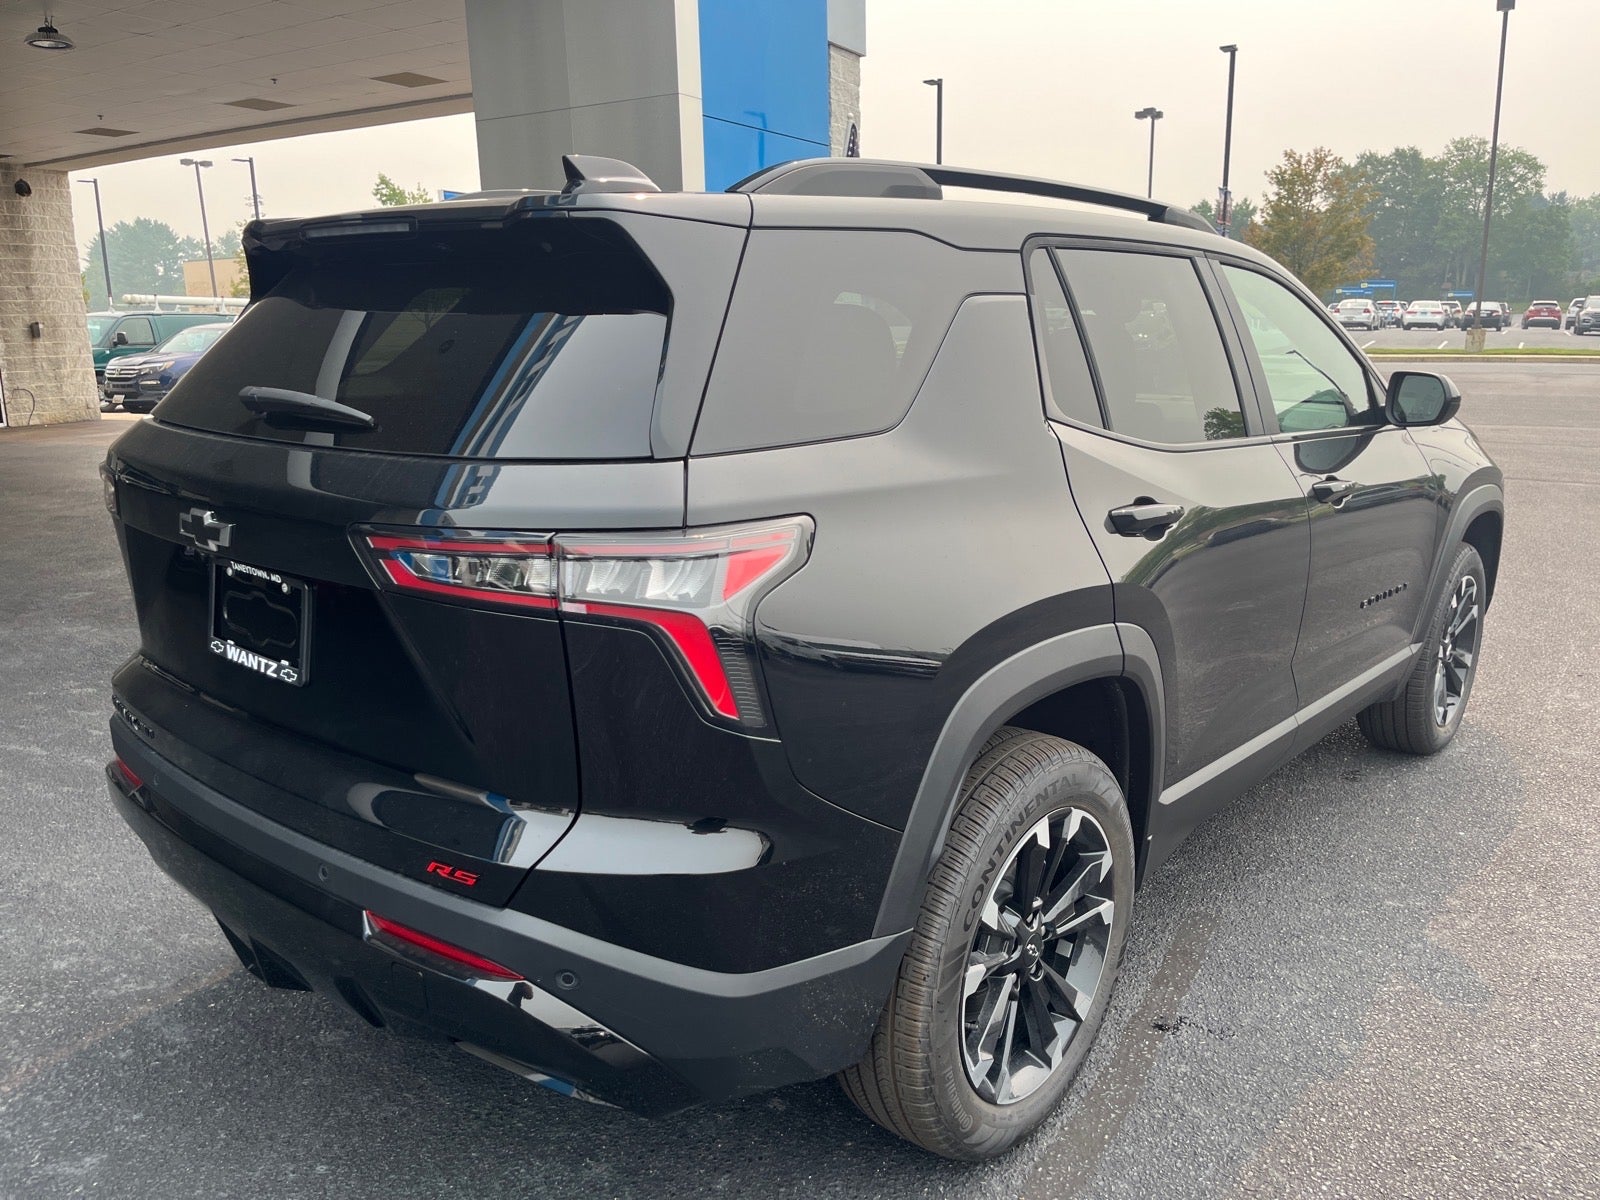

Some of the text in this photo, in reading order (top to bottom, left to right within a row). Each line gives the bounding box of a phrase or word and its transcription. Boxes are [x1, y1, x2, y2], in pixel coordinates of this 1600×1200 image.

[270, 573, 282, 584] MD
[226, 644, 278, 678] WANTZ
[963, 773, 1083, 933] CONTINENTAL
[426, 861, 480, 886] RS
